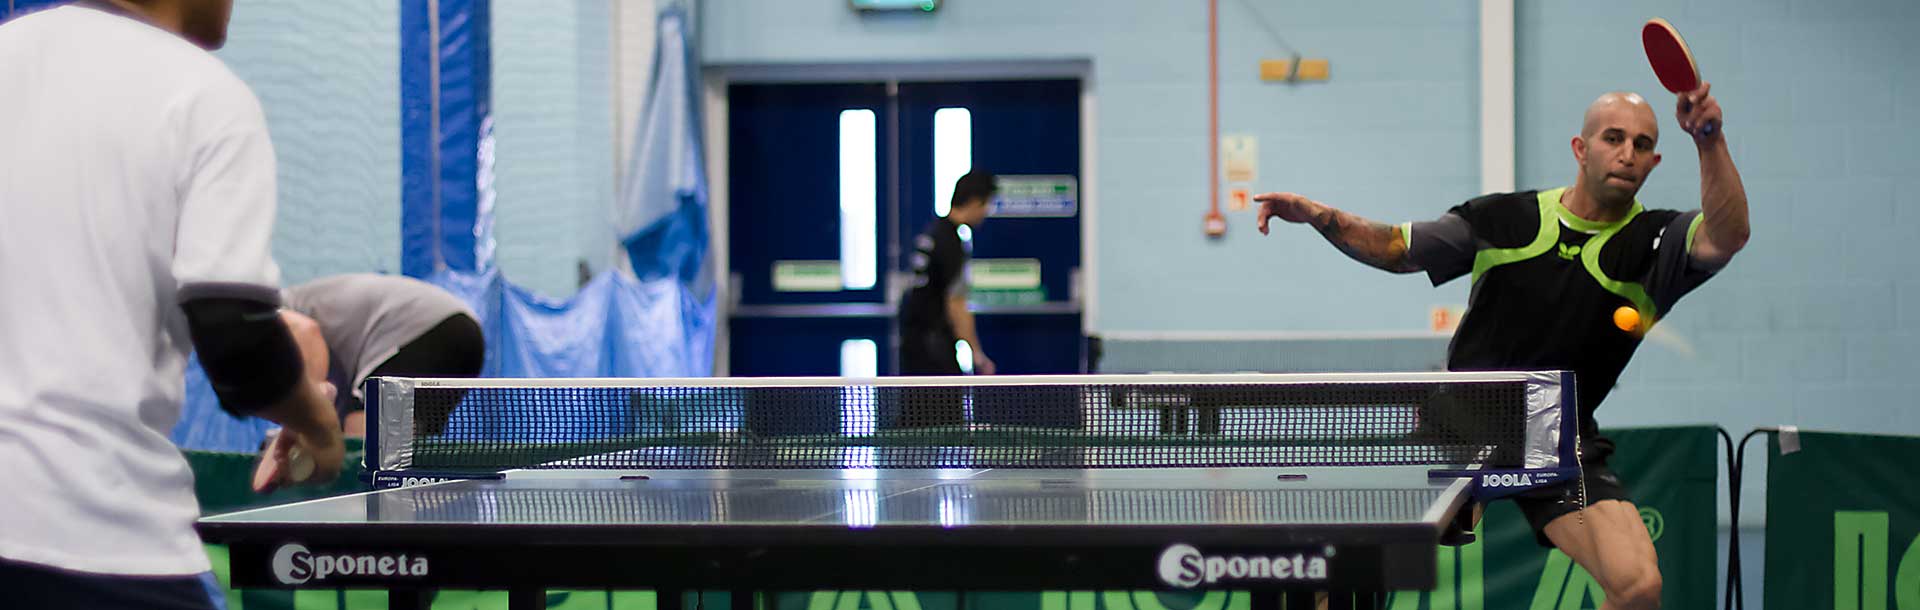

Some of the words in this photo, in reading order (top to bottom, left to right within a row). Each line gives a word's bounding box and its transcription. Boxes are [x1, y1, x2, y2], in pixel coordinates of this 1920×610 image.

[1482, 473, 1532, 487] JOOLA
[272, 543, 429, 585] Sponeta
[1159, 543, 1328, 588] Sponeta
